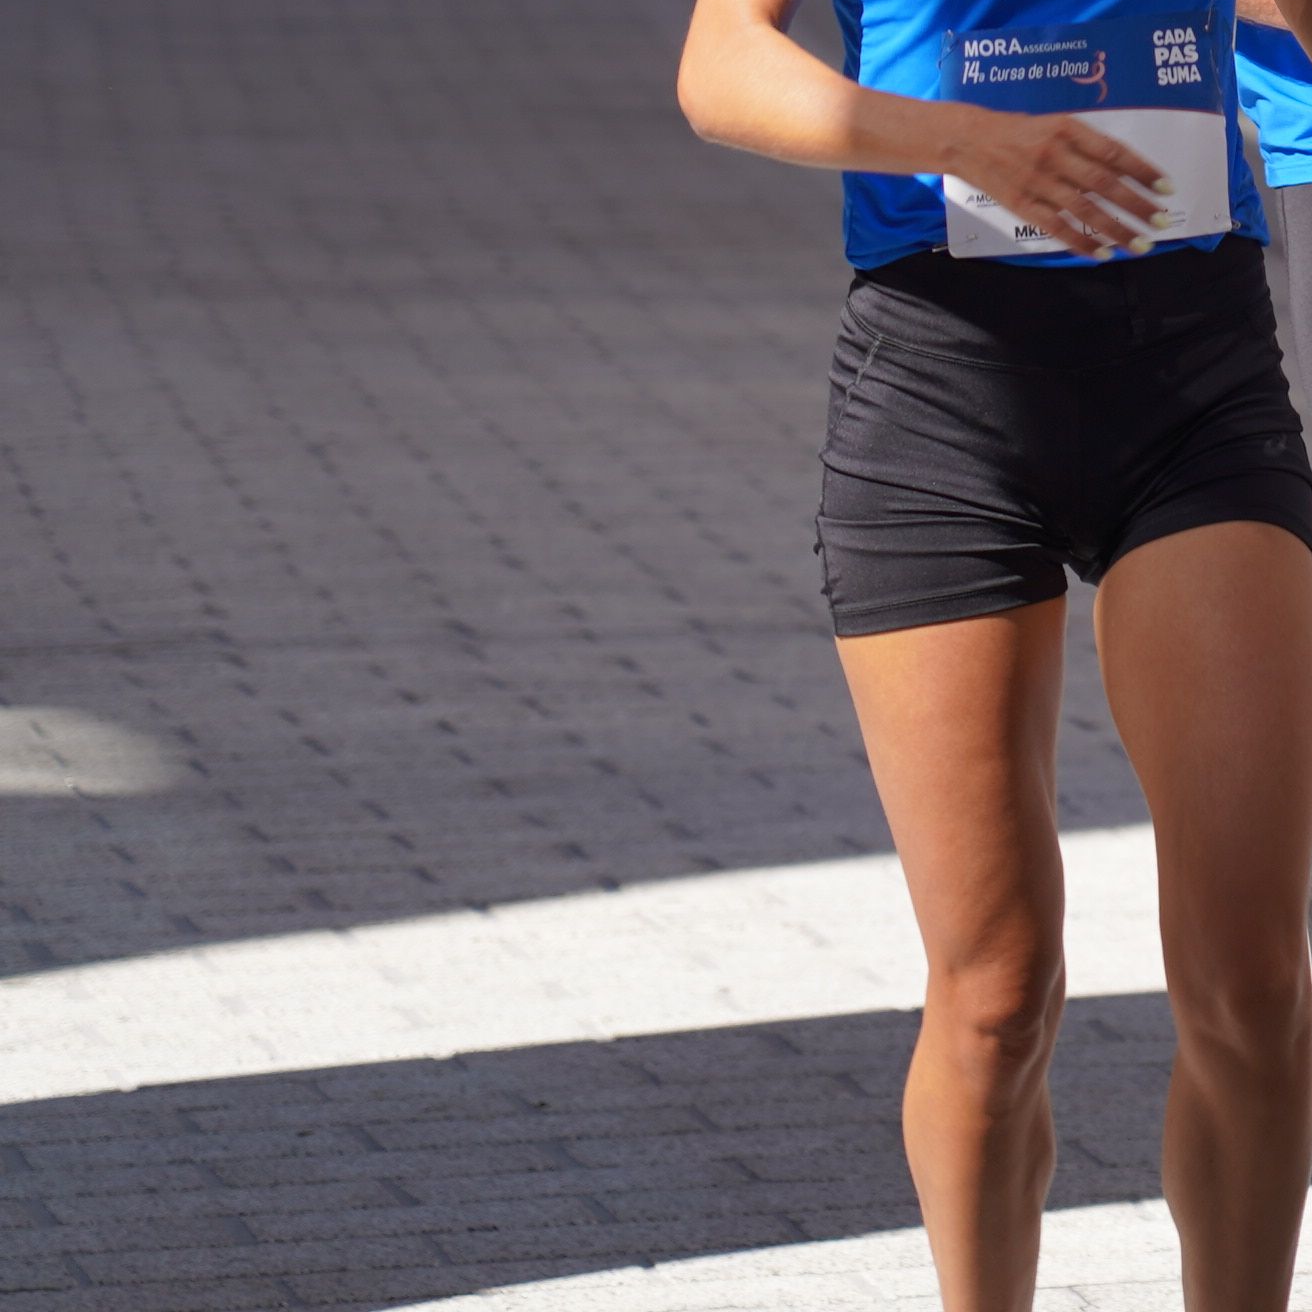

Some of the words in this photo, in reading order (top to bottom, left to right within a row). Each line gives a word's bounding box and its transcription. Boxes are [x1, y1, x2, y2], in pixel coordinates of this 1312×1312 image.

[964, 37, 1023, 58] MORA
[1023, 39, 1088, 54] ASSEGURANCES
[1152, 27, 1197, 46] CADA
[1154, 43, 1199, 66] PAS
[989, 65, 1025, 83] Cursa
[1027, 63, 1044, 80] de
[1060, 59, 1090, 77] Dona
[1157, 64, 1202, 86] SUMA
